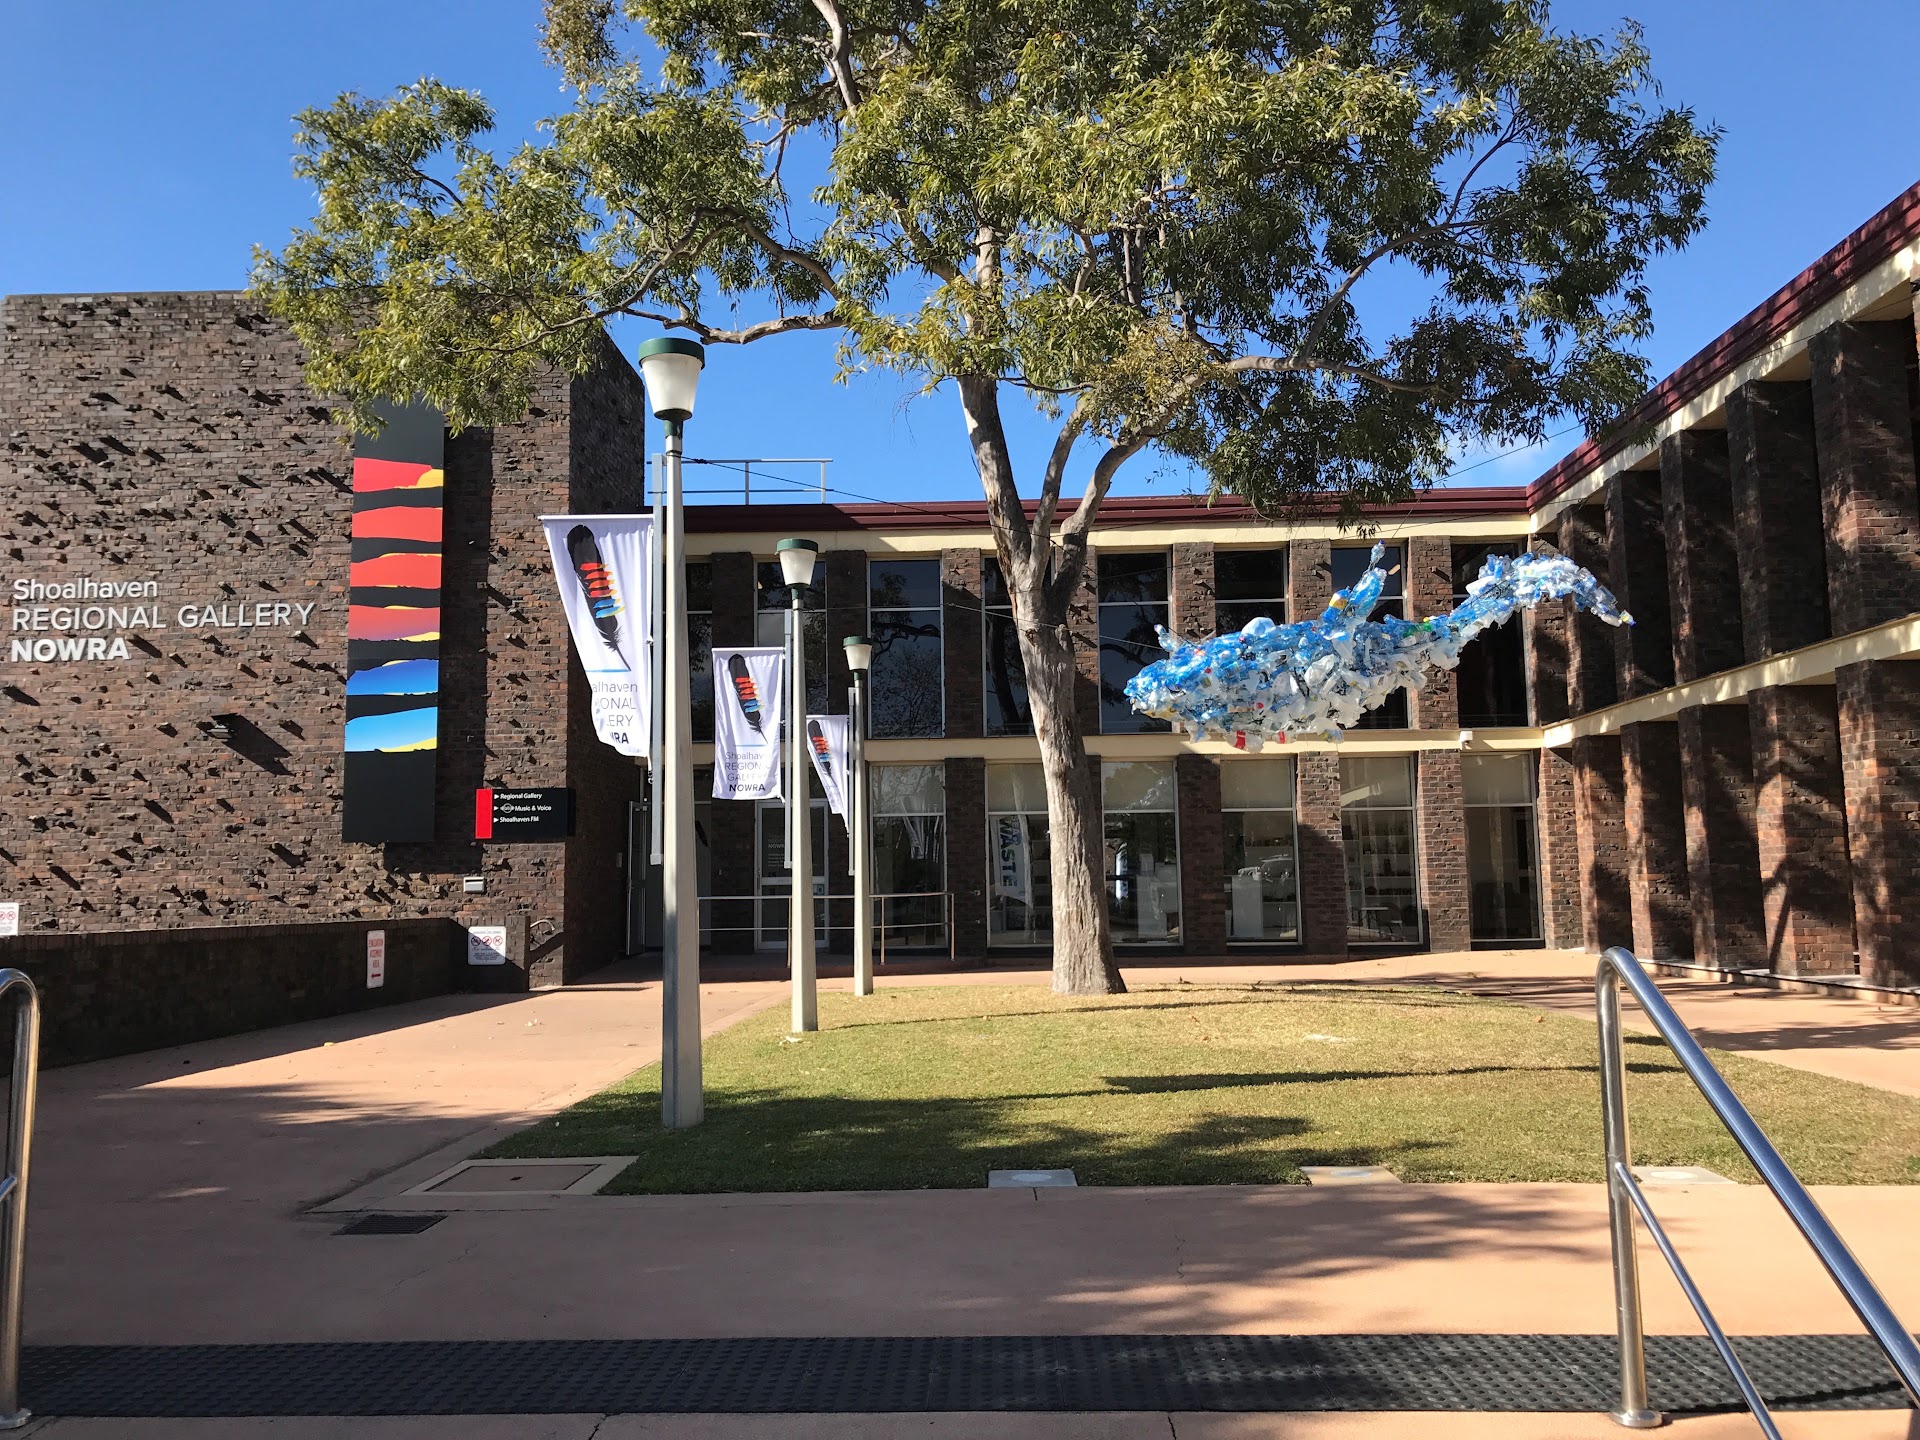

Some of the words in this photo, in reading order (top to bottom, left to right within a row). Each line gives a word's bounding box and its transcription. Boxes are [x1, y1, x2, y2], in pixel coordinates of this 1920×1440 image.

[12, 578, 158, 600] Shoalhaven
[12, 605, 167, 631] REGIONAL
[177, 602, 316, 628] GALLERY
[11, 637, 130, 662] NOWRA
[592, 682, 638, 693] alhaven
[599, 697, 637, 710] ONAL
[726, 752, 770, 760] Shoalhav
[725, 762, 771, 771] REGION
[729, 784, 766, 792] NOWRA
[1000, 815, 1018, 887] WASTE
